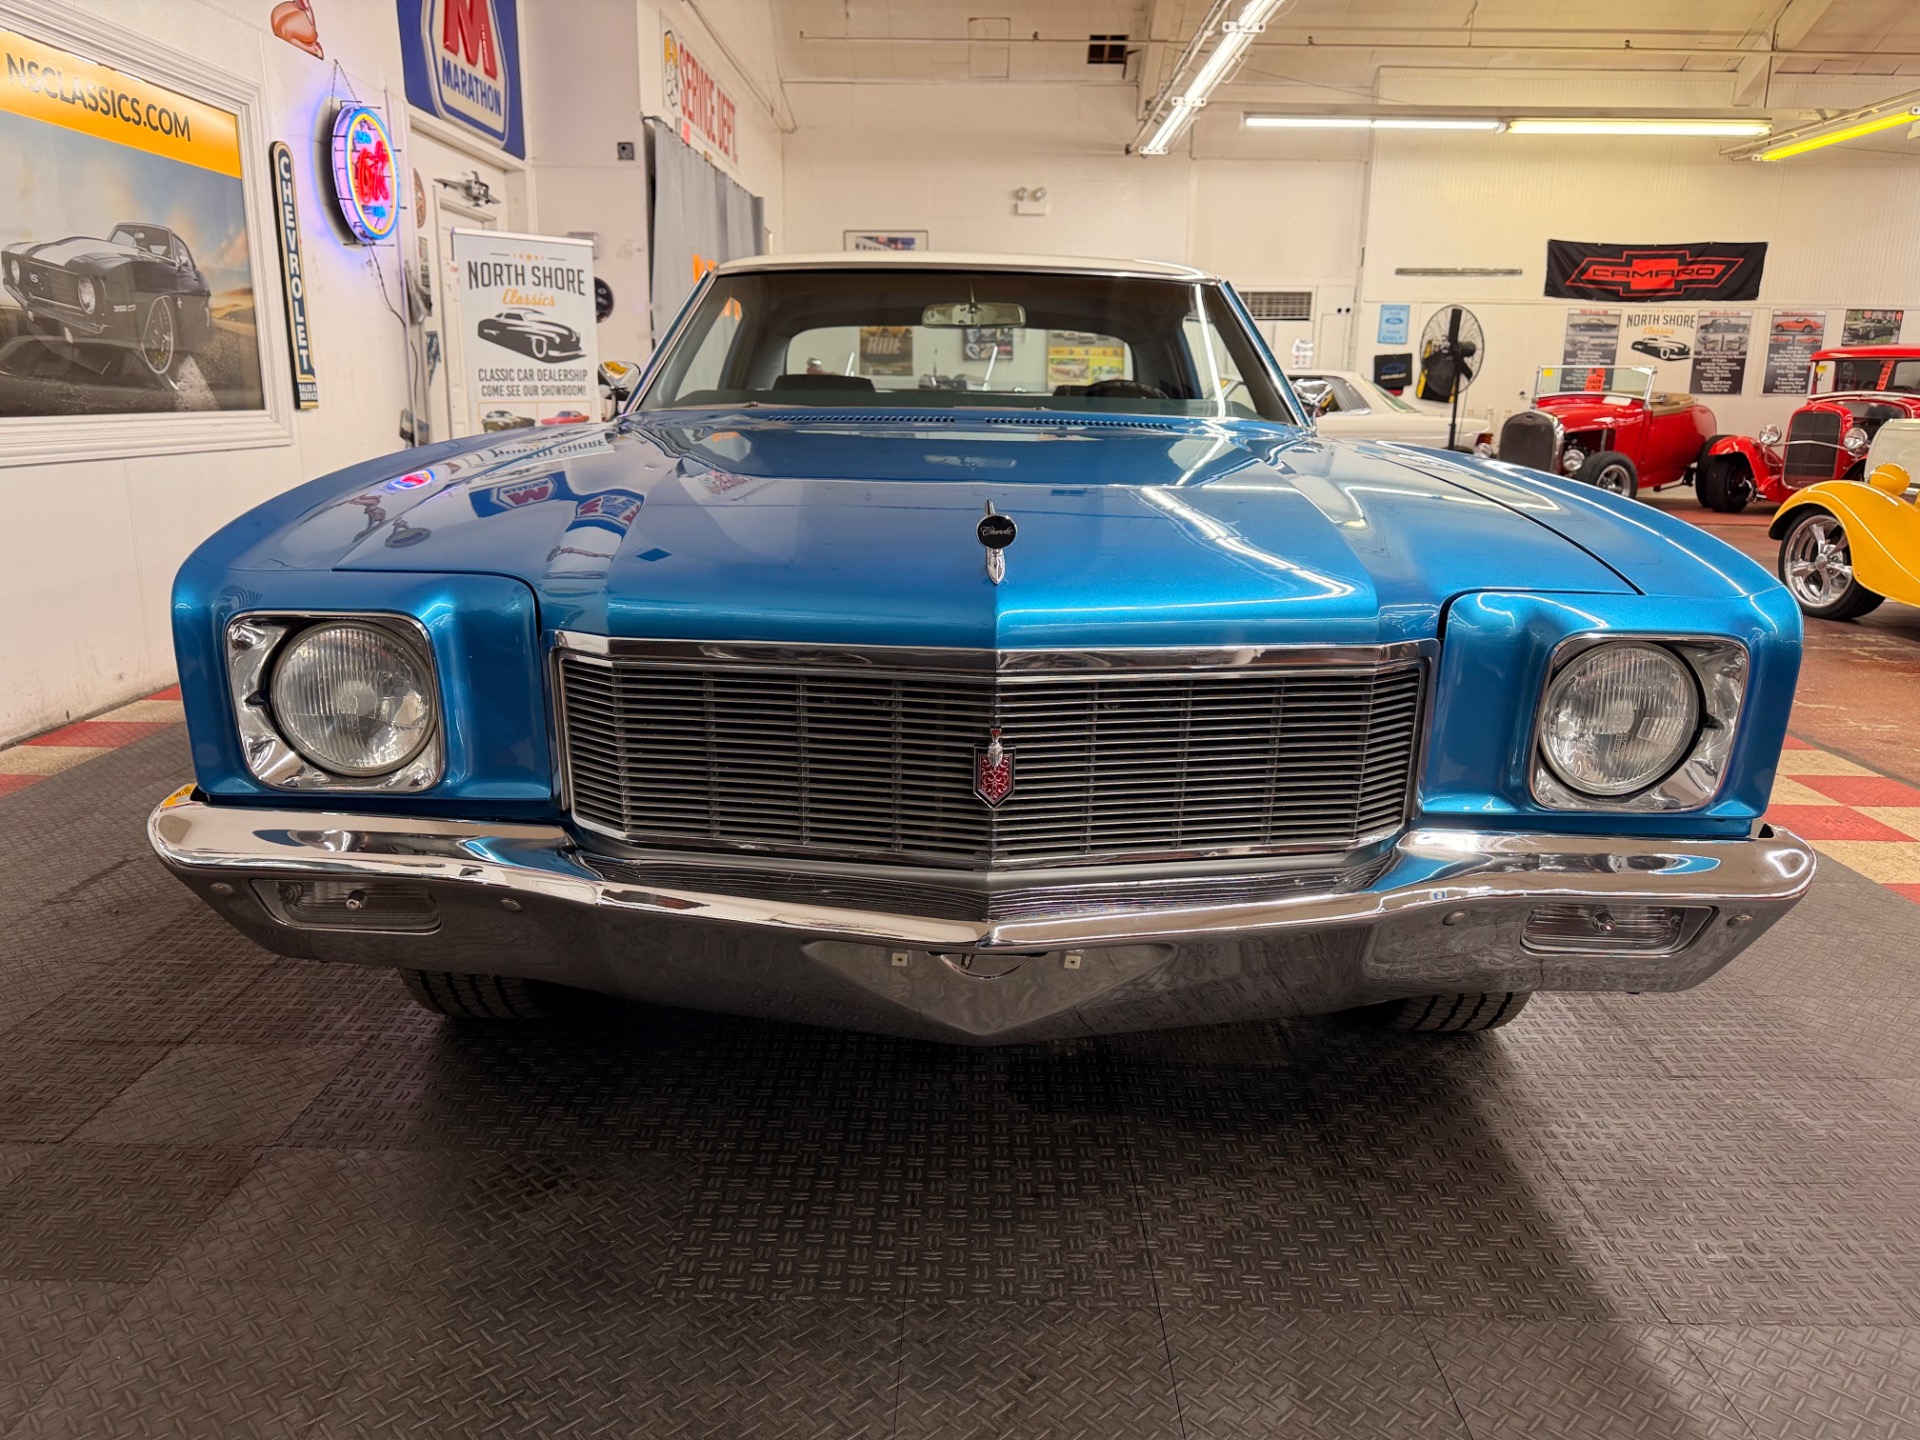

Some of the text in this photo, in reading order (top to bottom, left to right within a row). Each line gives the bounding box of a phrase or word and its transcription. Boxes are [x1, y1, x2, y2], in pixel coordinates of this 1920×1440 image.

[441, 56, 501, 117] MARATHON
[679, 42, 716, 145] SERVICE
[6, 52, 192, 142] NSCLASSICS.COM
[279, 155, 309, 370] CHEVROLET
[467, 261, 586, 296] NORTH SHORE
[1592, 267, 1716, 278] CAMARO
[502, 288, 556, 307] Classics
[1626, 314, 1696, 329] NORTH SHORE
[1643, 327, 1675, 335] Classics
[866, 337, 902, 355] RIDE
[478, 368, 588, 382] CLASSIC CAR DEALERSHIP
[482, 384, 587, 397] COME SEE OUR SHOWROOM!
